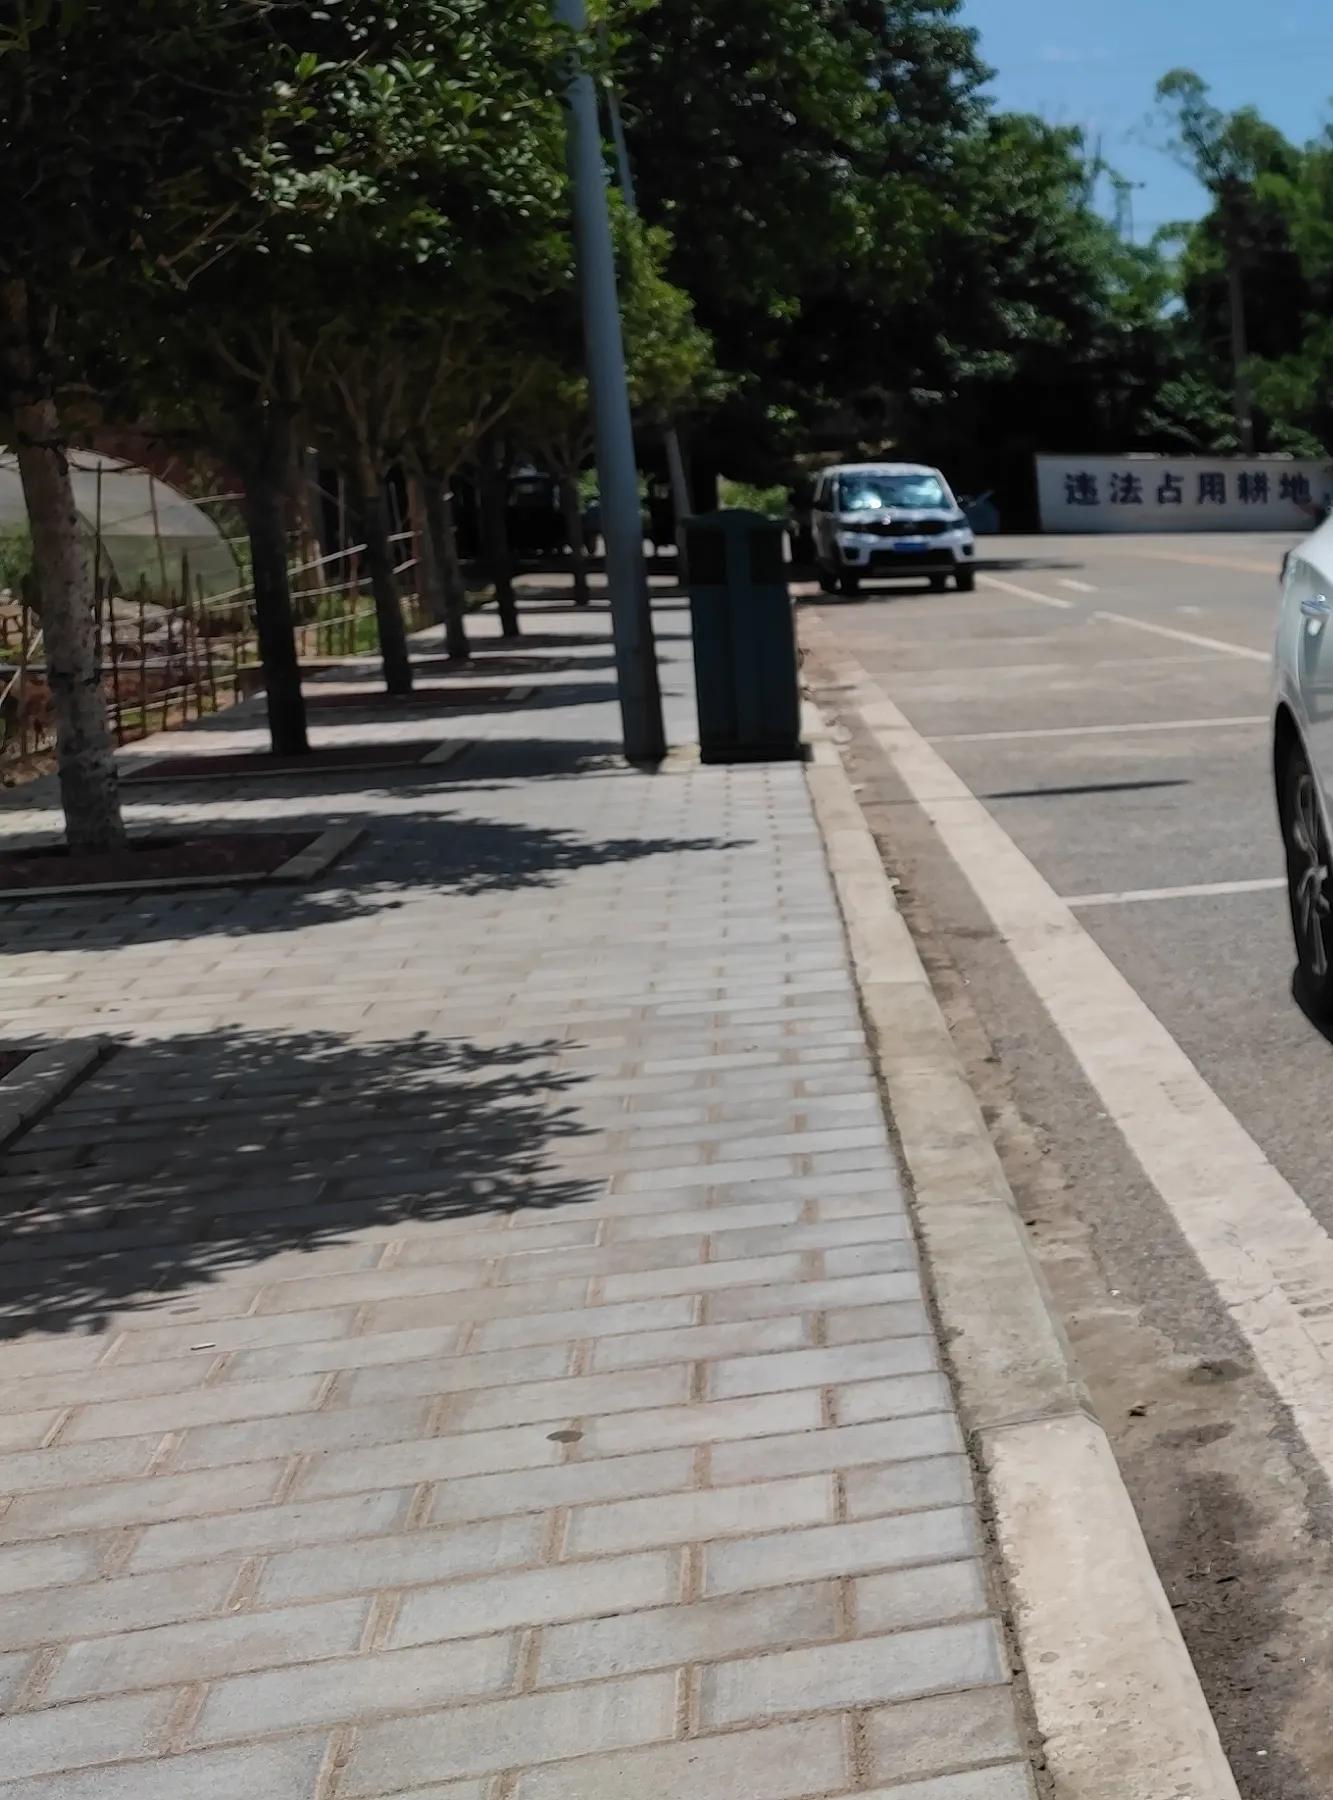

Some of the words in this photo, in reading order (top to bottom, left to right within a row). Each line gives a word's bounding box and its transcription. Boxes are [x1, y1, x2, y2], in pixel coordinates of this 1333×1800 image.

[1065, 472, 1312, 505] 违法占用耕地
